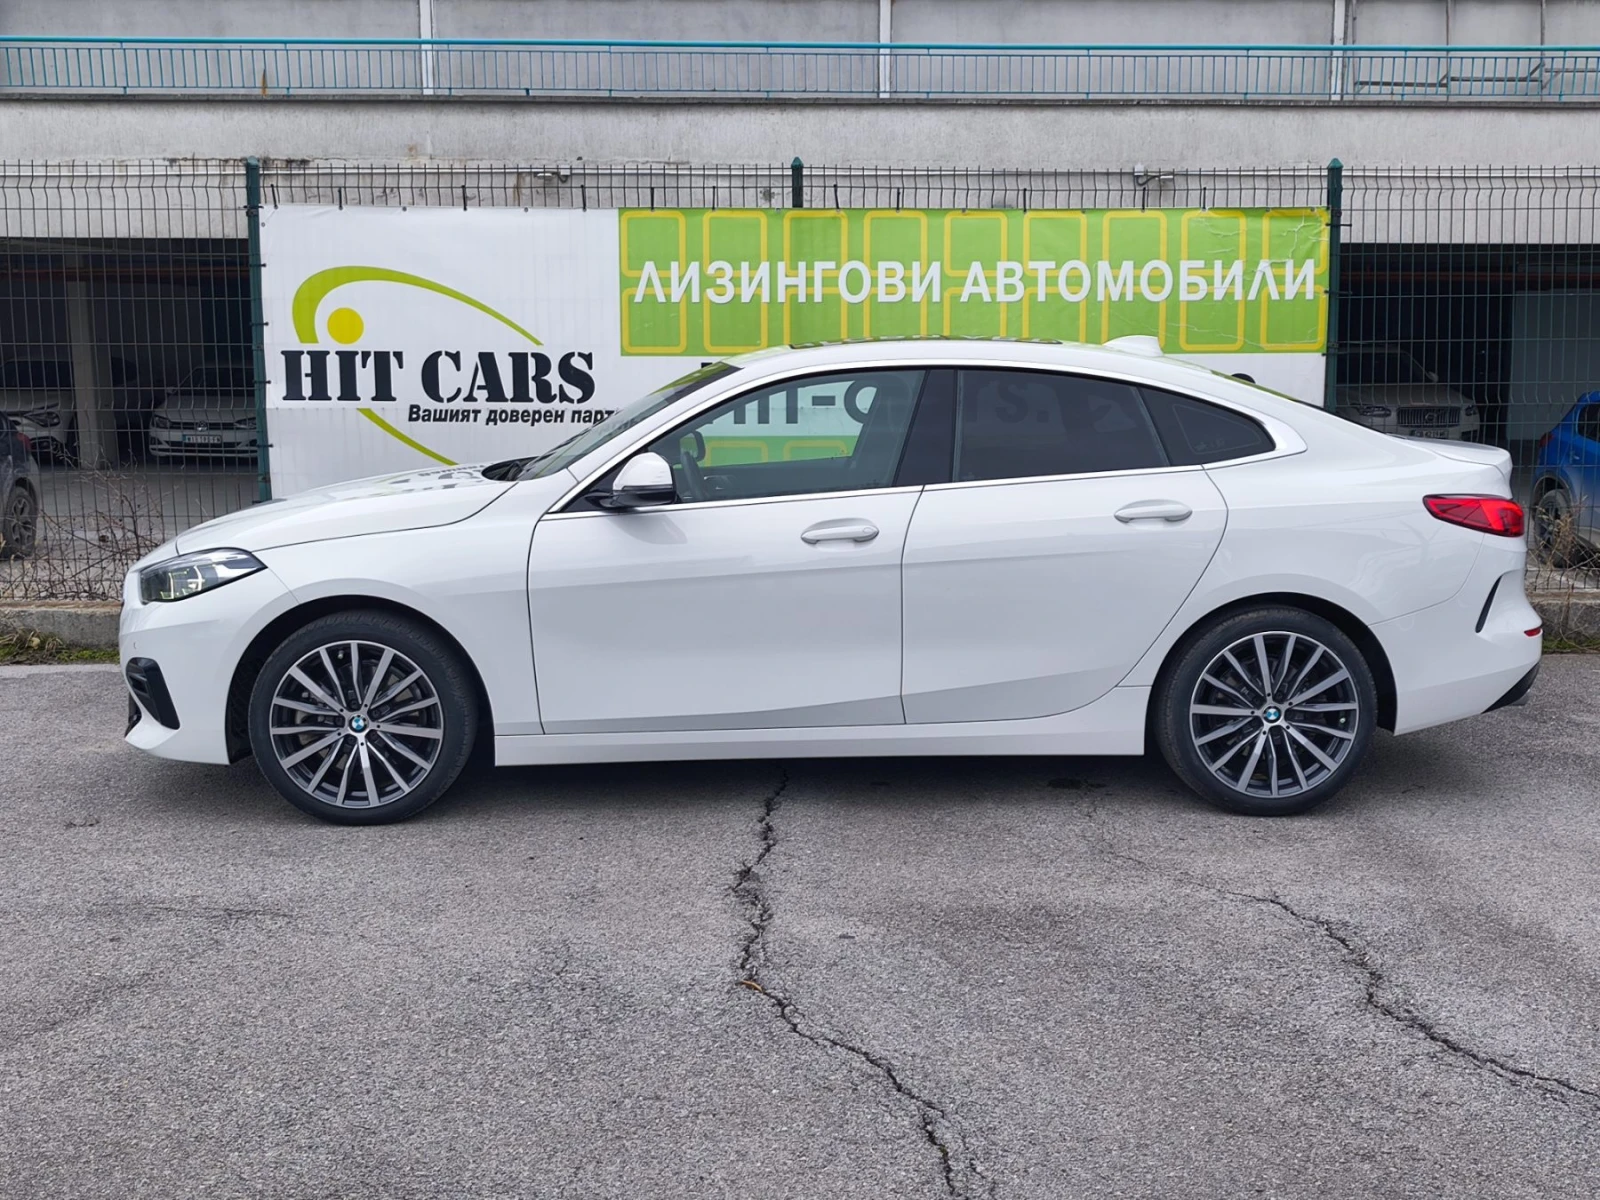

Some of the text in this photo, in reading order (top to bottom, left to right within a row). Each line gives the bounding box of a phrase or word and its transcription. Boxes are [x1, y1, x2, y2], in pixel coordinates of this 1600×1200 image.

[634, 258, 1315, 304] ЛИЗИНГОВИ АВТОМОБИЛИ
[280, 350, 596, 405] HIT CARS
[407, 404, 617, 427] Вашият доверен парт
